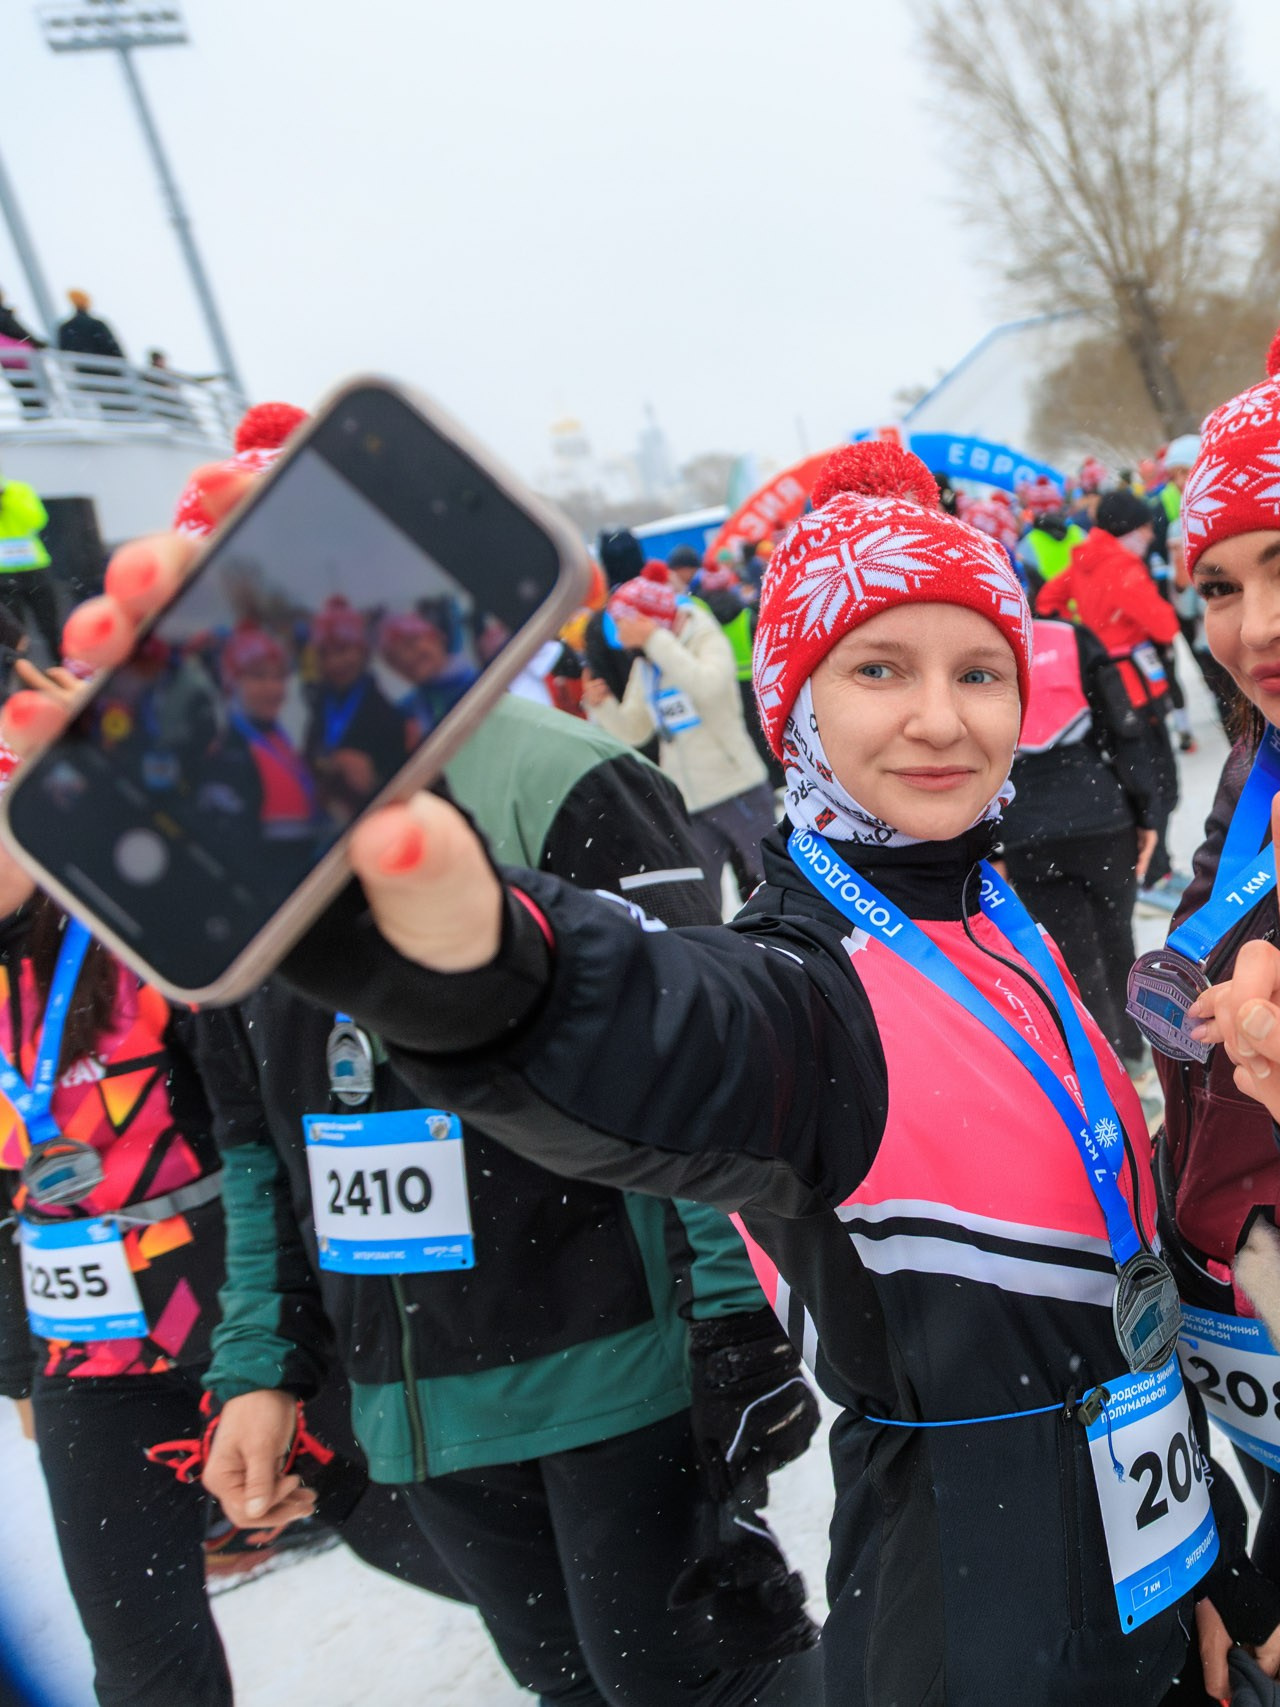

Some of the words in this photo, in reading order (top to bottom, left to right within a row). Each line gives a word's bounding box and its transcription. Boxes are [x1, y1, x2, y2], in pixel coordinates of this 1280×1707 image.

[791, 828, 903, 938] ГОРОДСКОЙ
[1225, 891, 1244, 905] 7
[1242, 871, 1271, 894] КМ
[1080, 1128, 1099, 1161] КМ
[327, 1166, 433, 1216] 2410
